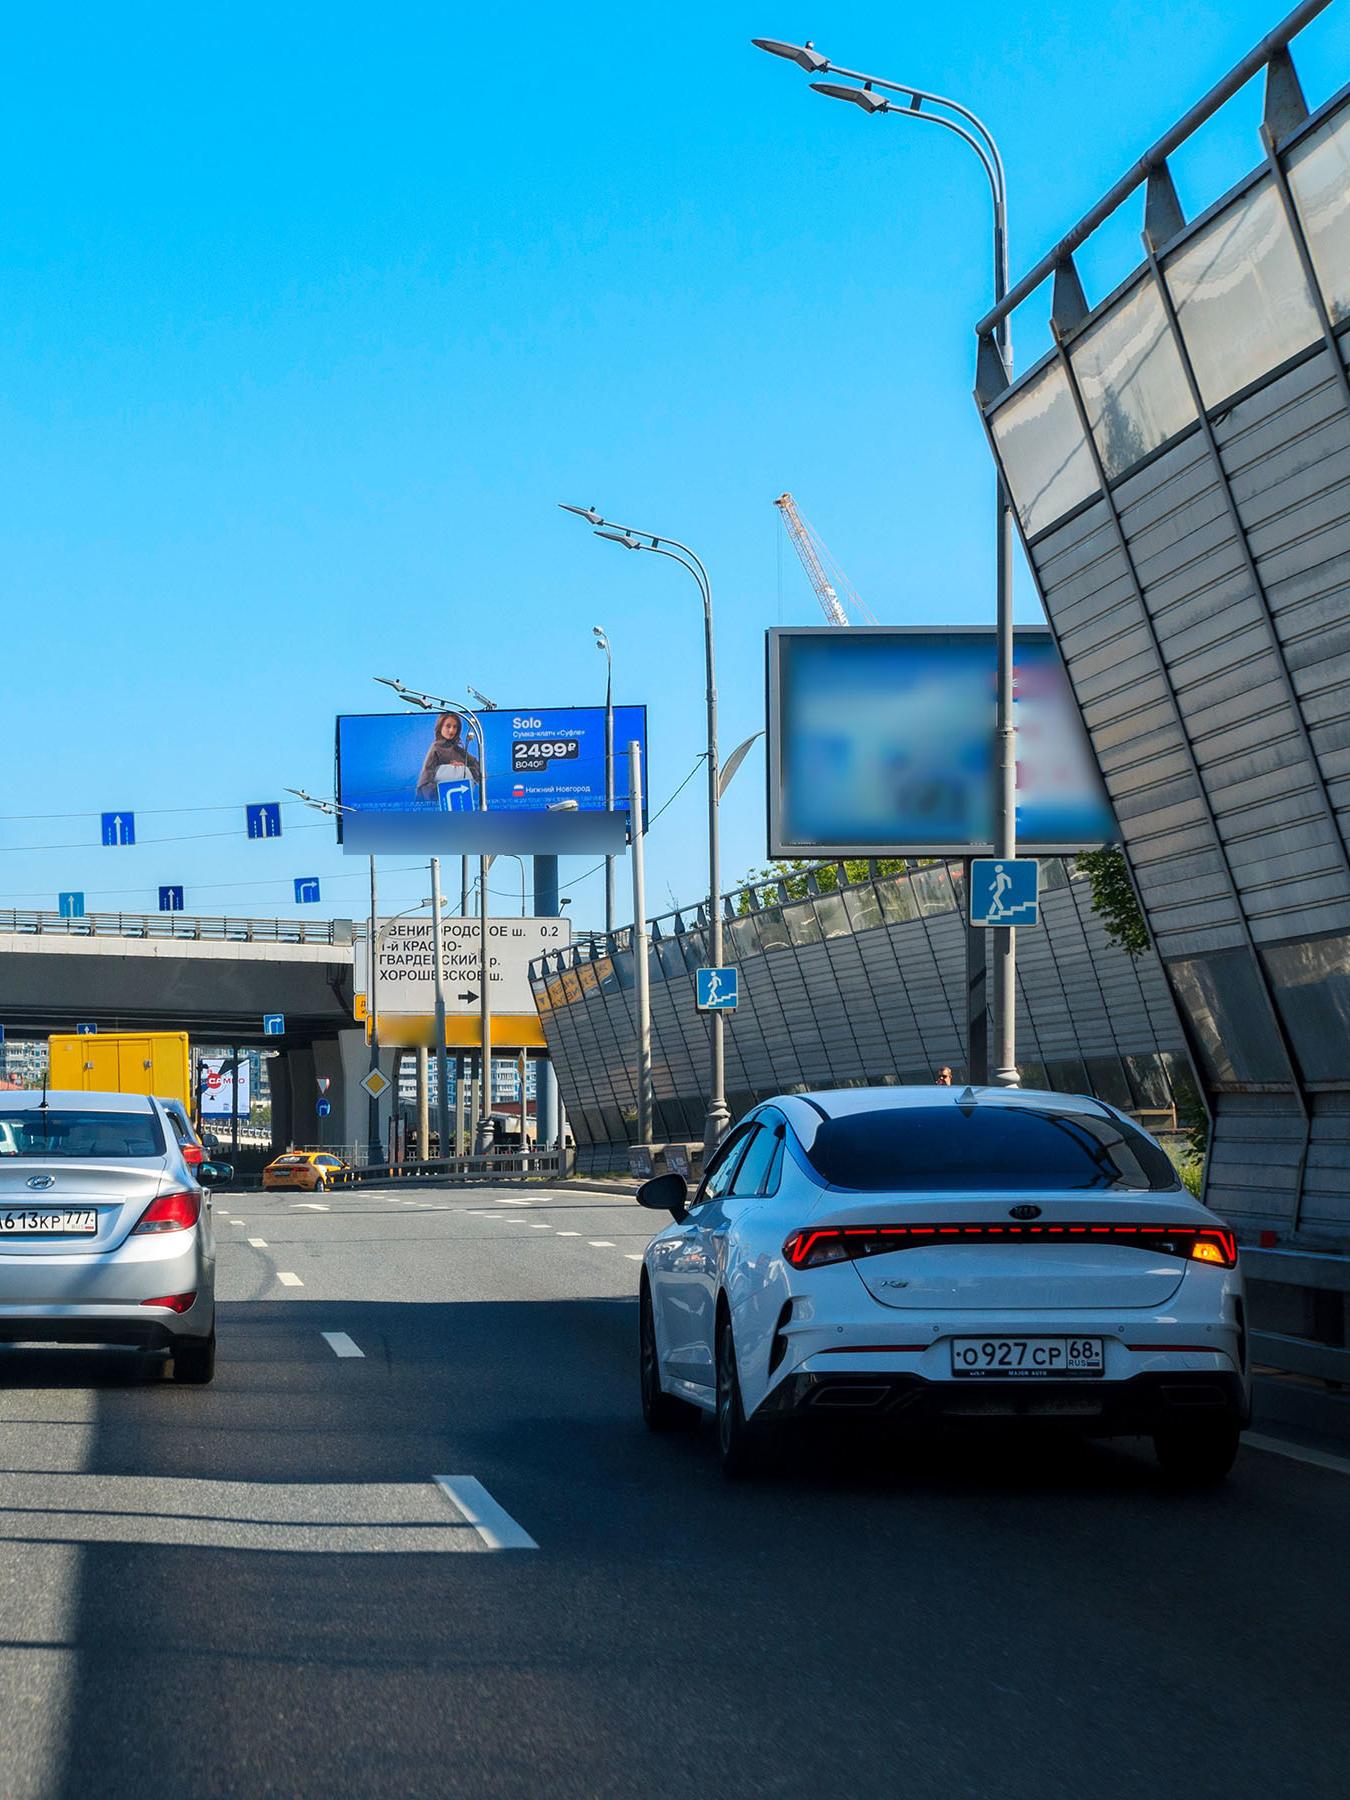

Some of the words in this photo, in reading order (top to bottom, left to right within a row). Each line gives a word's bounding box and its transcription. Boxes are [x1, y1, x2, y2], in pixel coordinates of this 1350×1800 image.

[512, 717, 542, 729] Solo
[512, 730, 556, 739] Сумка-клатч
[525, 786, 555, 794] Нижний
[555, 784, 591, 793] Новгород
[512, 928, 527, 937] ш.
[540, 926, 559, 937] 0.2
[379, 952, 477, 967] ГВАРДЕСКИЙ
[65, 1211, 91, 1224] 777
[1069, 1341, 1093, 1359] 68
